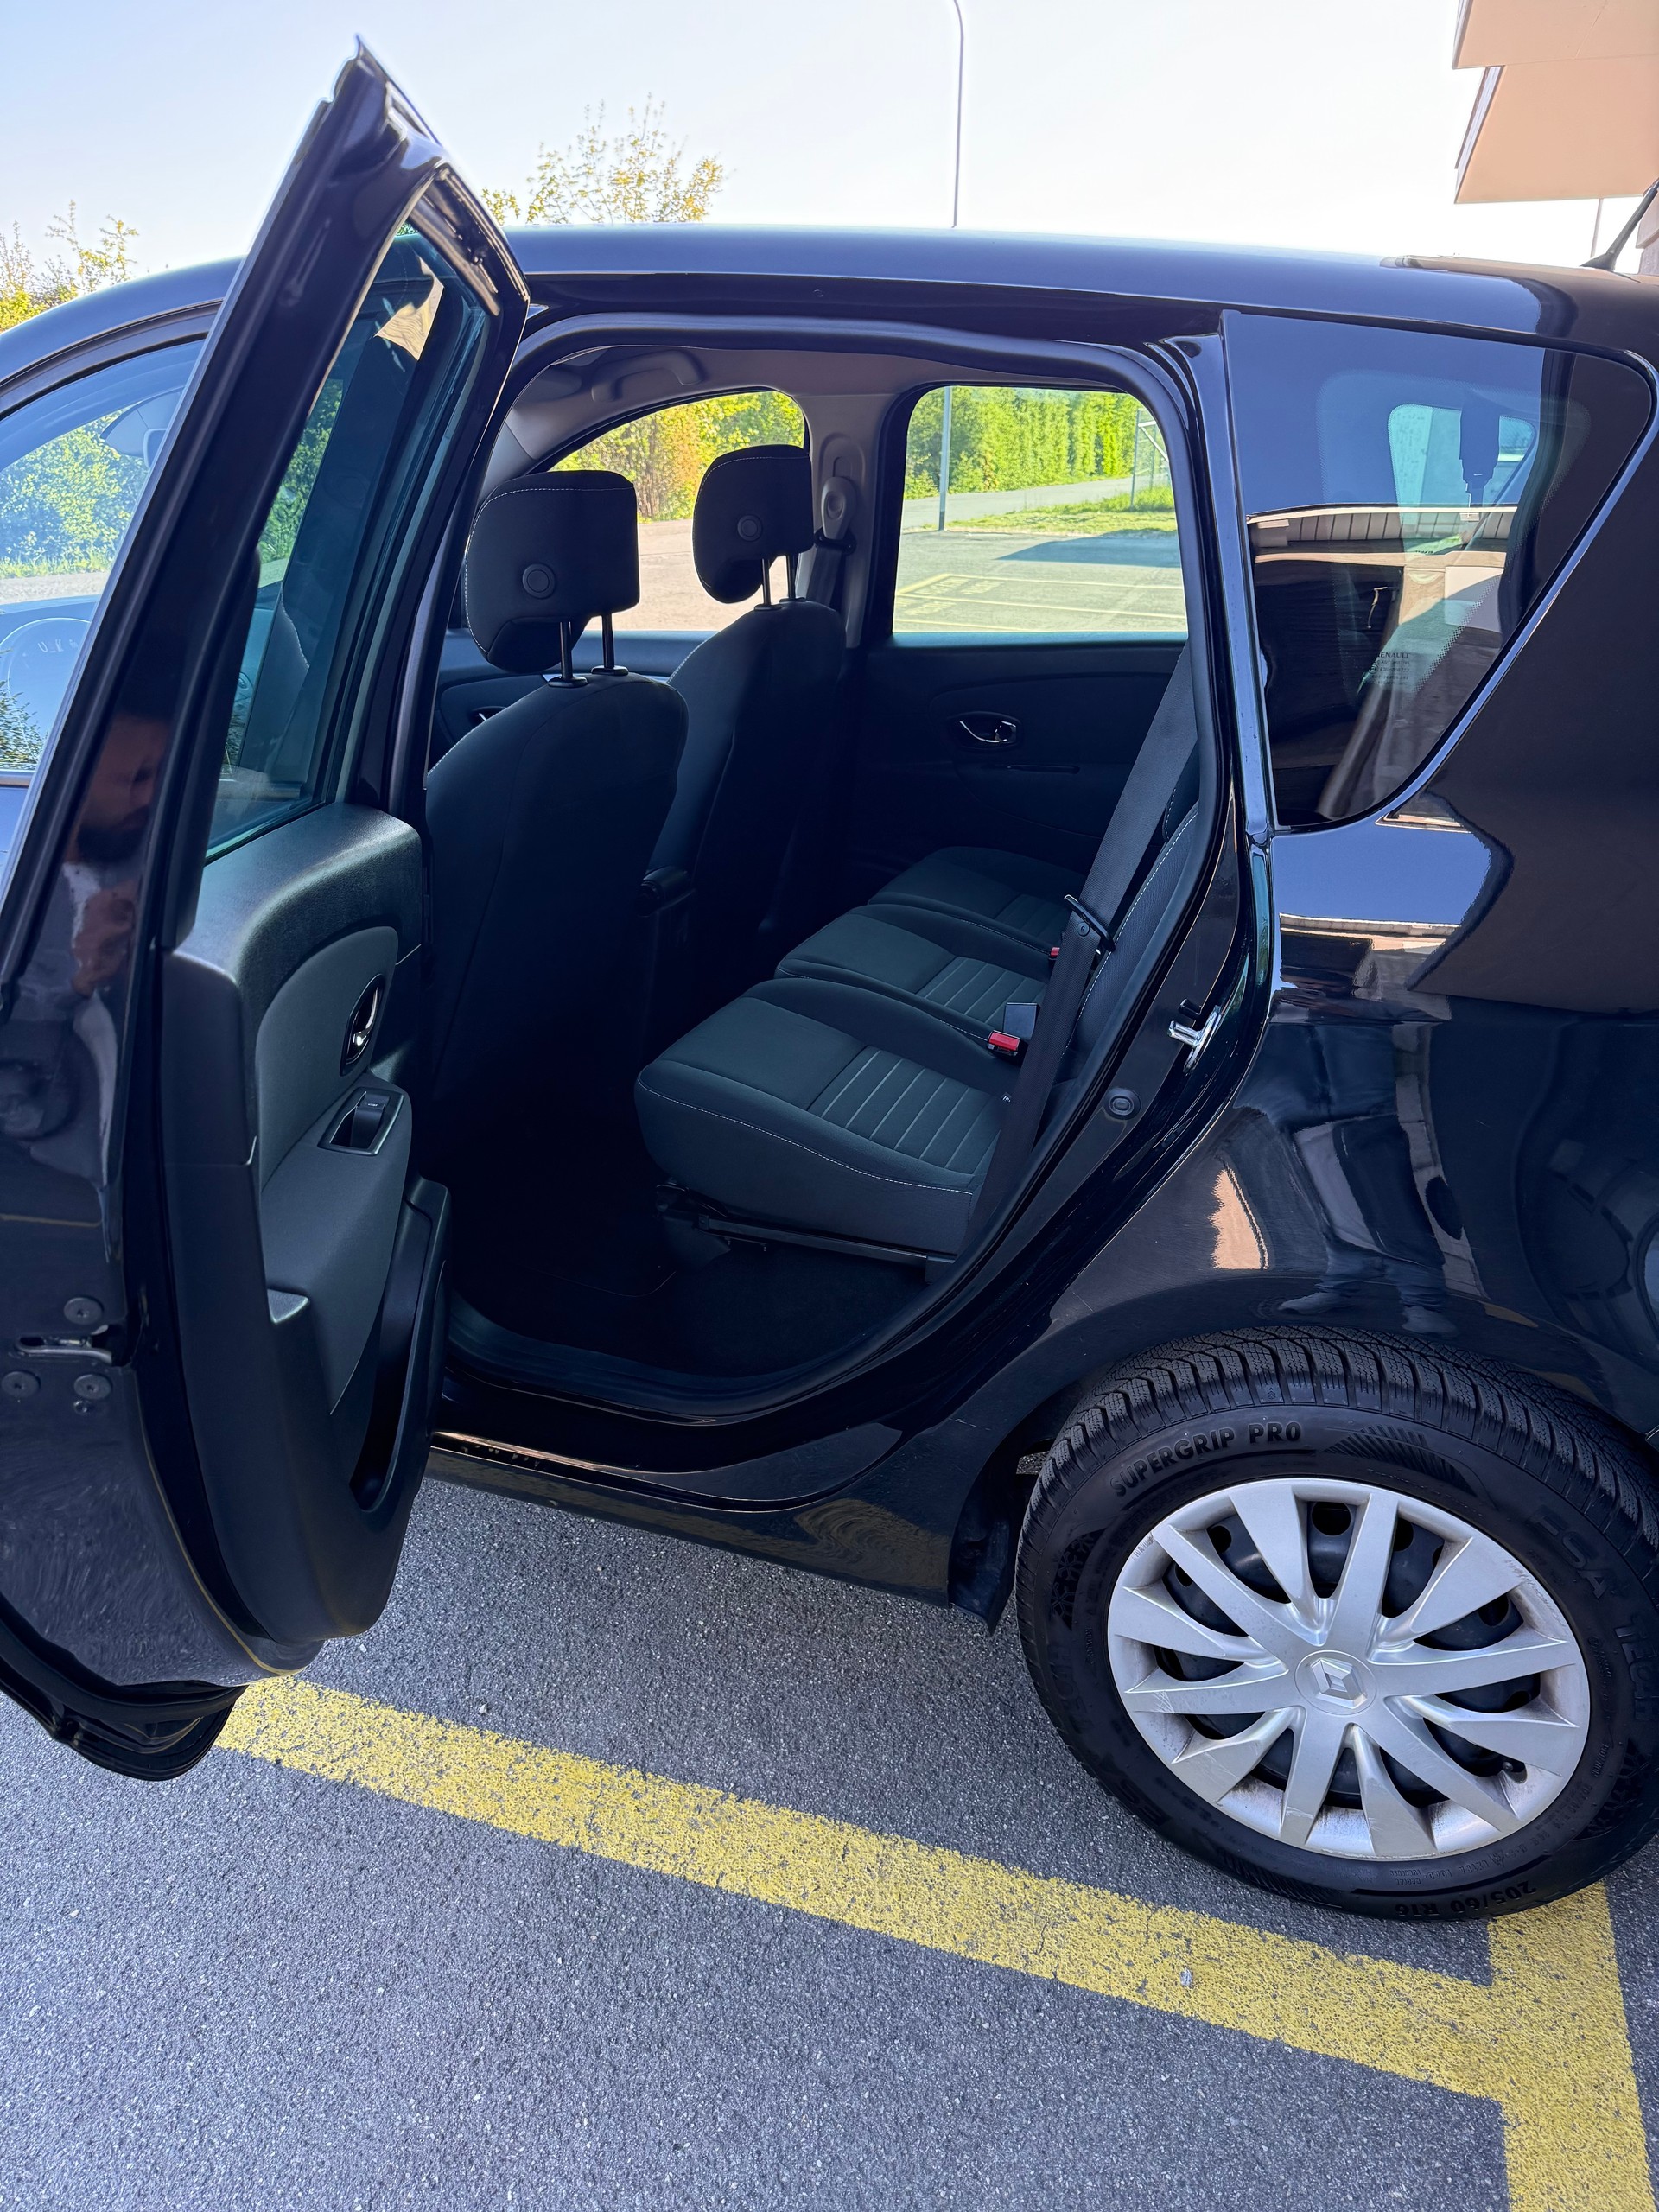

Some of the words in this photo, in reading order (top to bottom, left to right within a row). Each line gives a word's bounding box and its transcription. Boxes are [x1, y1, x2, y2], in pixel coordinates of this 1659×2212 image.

[1109, 1427, 1236, 1497] SUPERGRIP
[1248, 1421, 1302, 1444] PRO
[1394, 1902, 1440, 1917] R16
[1450, 1879, 1537, 1913] 205/60
